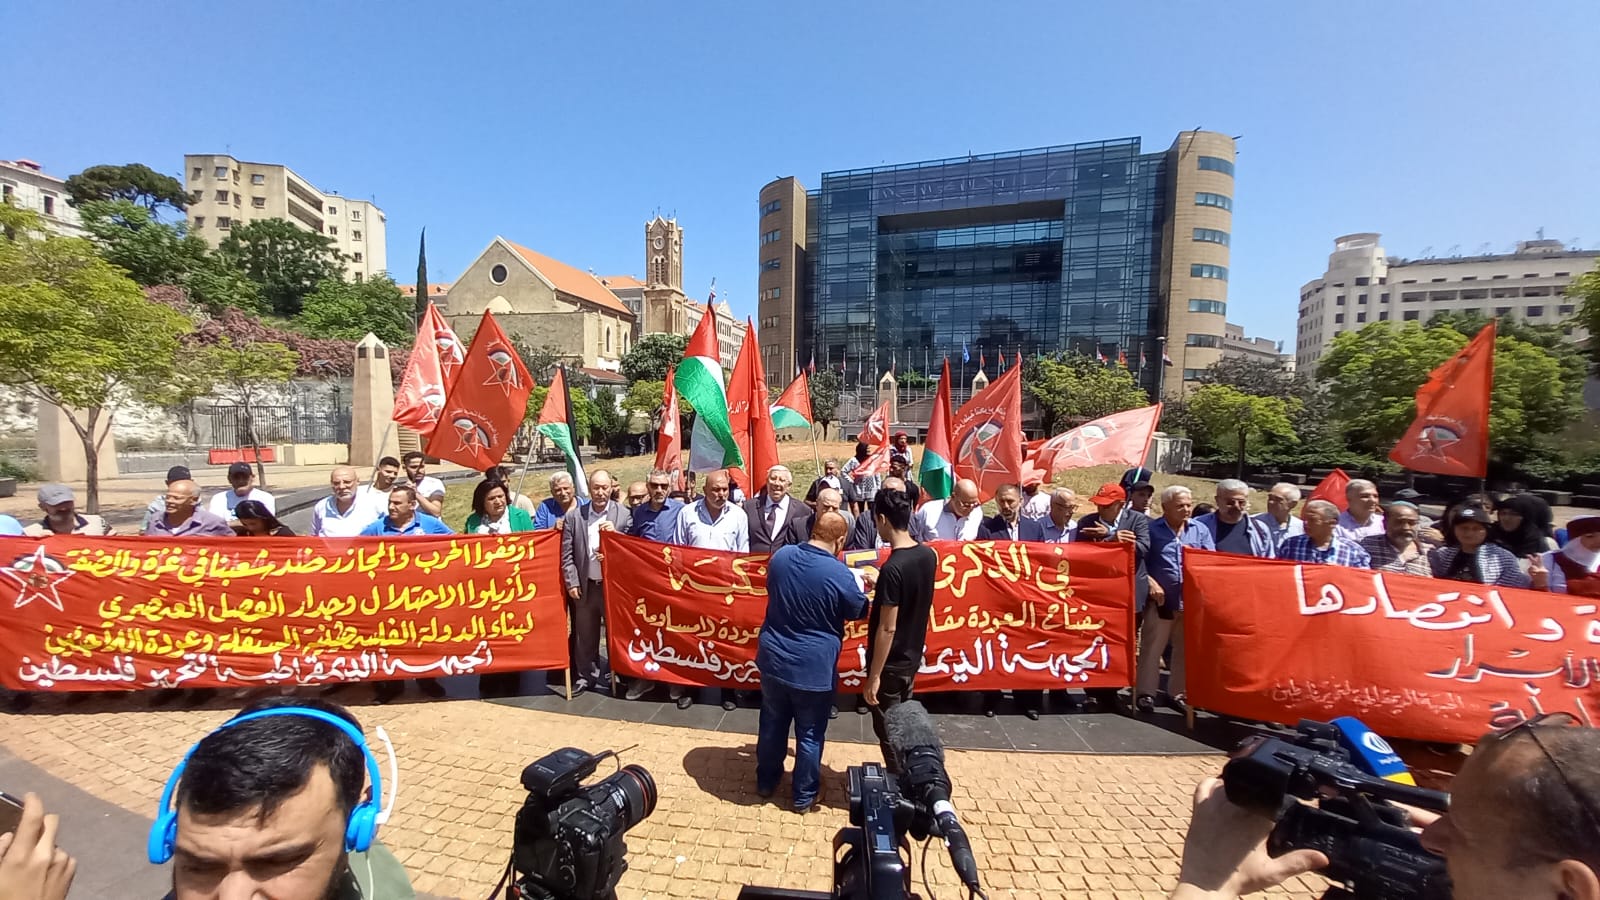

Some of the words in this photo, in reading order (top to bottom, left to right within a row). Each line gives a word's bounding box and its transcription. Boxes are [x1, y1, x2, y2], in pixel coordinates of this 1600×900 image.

[66, 549, 141, 578] والضفة
[141, 547, 182, 581] غزة
[177, 548, 209, 588] في
[209, 549, 276, 587] شعبنا
[270, 547, 327, 577] ضد
[321, 541, 410, 580] والمجازر
[415, 540, 471, 575] الحرب
[933, 541, 1031, 598] الذكرى
[1035, 546, 1070, 600] في
[208, 587, 285, 623] الفصل
[287, 585, 357, 621] وجدار
[360, 582, 466, 616] الاحتلال
[468, 563, 537, 611] وأزيلوا
[417, 614, 486, 648] الدولة
[487, 611, 534, 643] لبناء
[967, 600, 1036, 634] العودة
[1041, 601, 1105, 631] مفتاح
[144, 629, 214, 658] وعودة
[217, 624, 301, 654] المستقلة
[302, 617, 417, 656] الفلسطينية
[627, 627, 722, 673] فلسطين
[18, 654, 136, 688] فلسطين
[209, 651, 378, 687] الديمقراطية
[378, 640, 494, 676] الجبهة
[997, 633, 1109, 682] الجبهة
